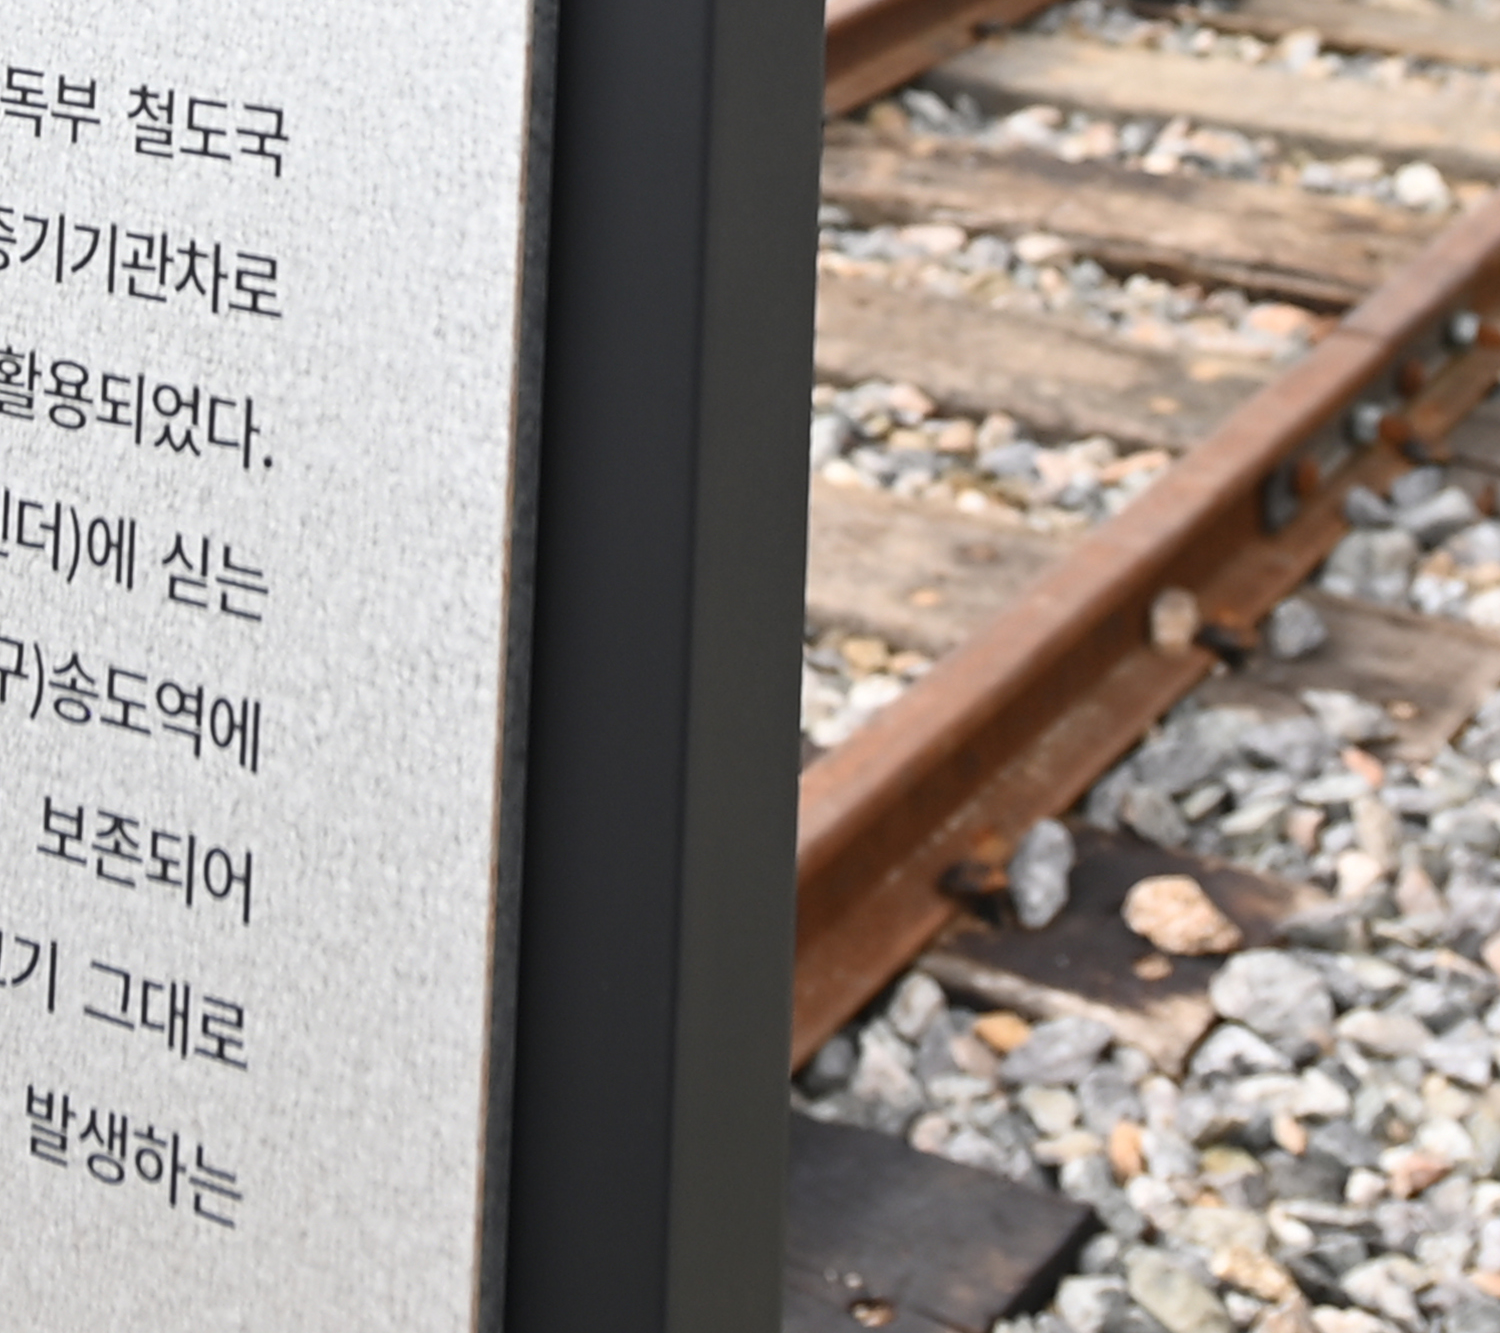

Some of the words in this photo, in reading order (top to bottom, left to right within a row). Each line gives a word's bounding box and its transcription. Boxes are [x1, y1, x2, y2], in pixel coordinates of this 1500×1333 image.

[126, 83, 290, 179] 철도국
[160, 532, 270, 623] 싣는
[36, 794, 254, 927] 보존되어
[82, 960, 248, 1071] 그대로
[24, 1083, 243, 1229] 발생하는
